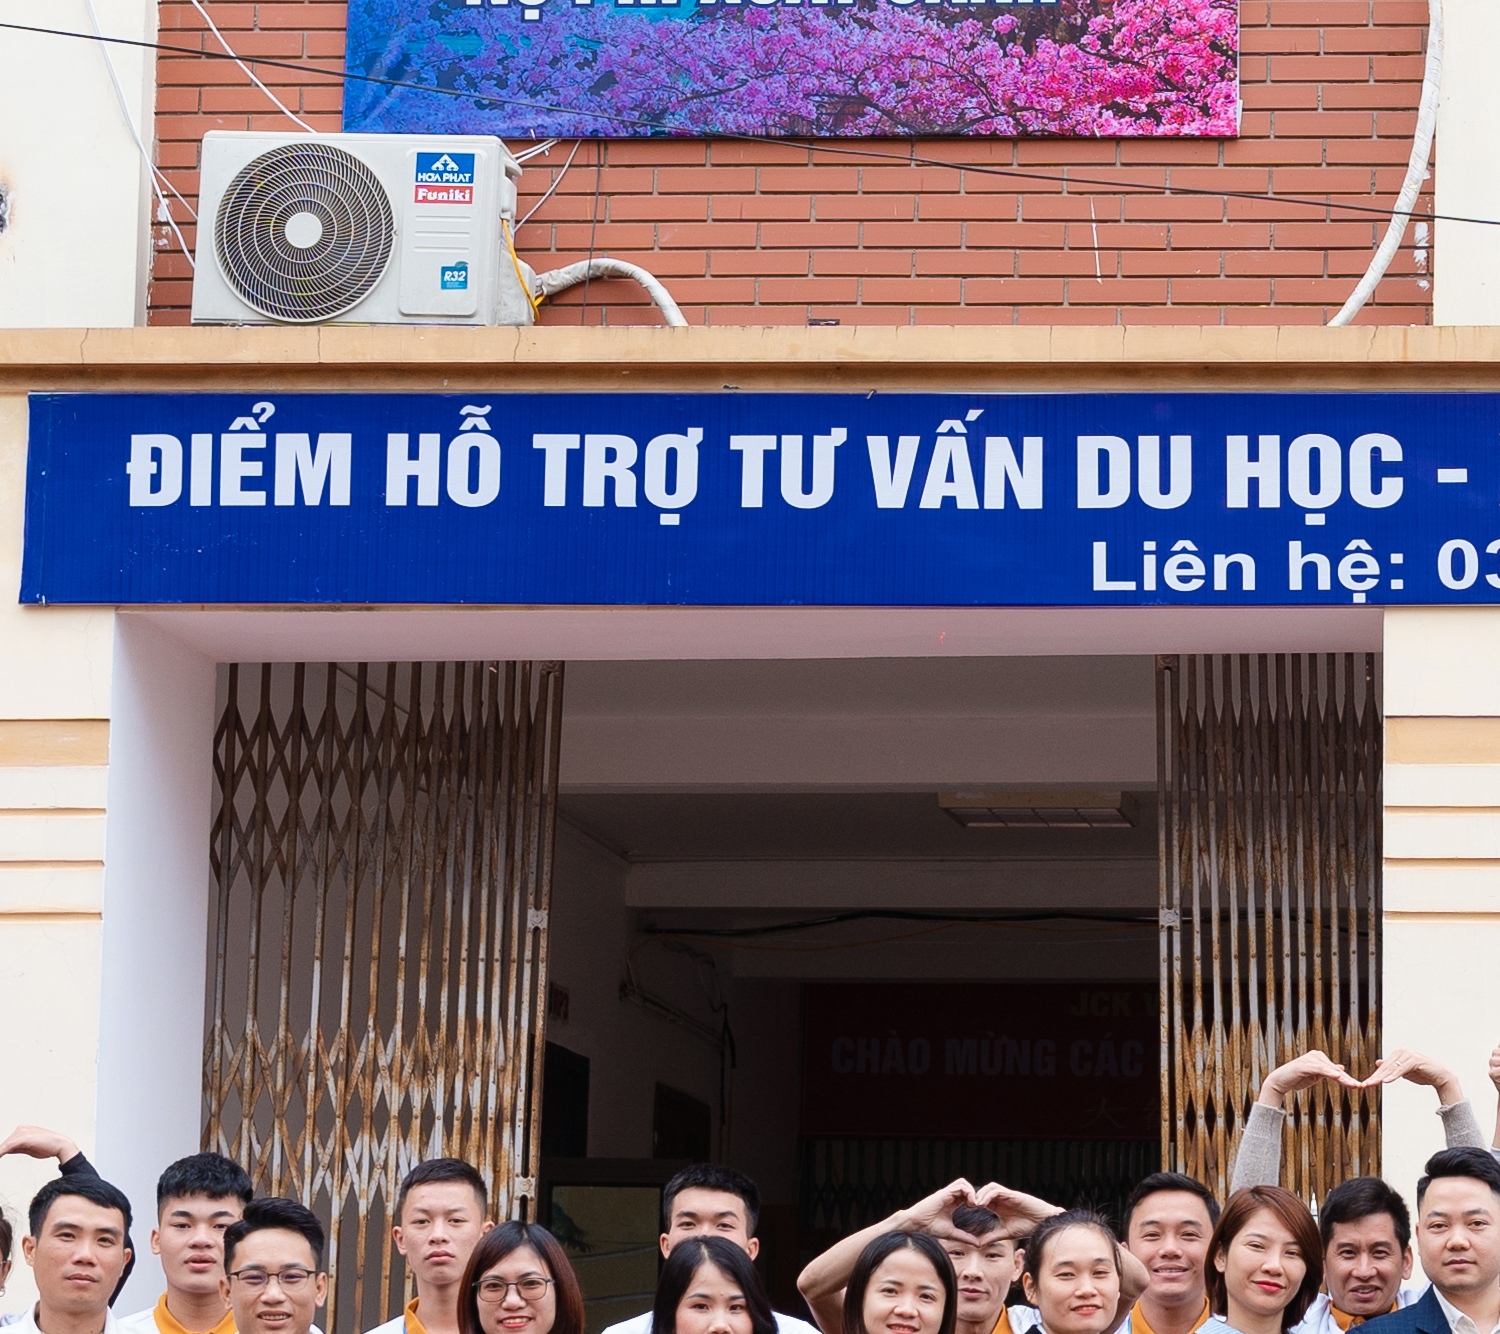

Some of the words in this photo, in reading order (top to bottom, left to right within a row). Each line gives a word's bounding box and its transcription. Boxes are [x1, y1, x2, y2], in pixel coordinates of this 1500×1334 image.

[417, 188, 470, 203] Funiki
[444, 271, 466, 281] R32
[127, 401, 351, 506] ĐIỂM
[386, 404, 500, 507] HỖ
[533, 428, 703, 526] TRỢ
[730, 428, 847, 508] TƯ
[867, 410, 1042, 509] VẤN
[1078, 436, 1191, 509] DU
[1227, 433, 1403, 526] HỌC
[1093, 540, 1255, 592] Liên
[1287, 538, 1405, 601] hệ:
[832, 1029, 929, 1075] CHÀO
[945, 1030, 1056, 1076] MỪNG
[1070, 1032, 1143, 1076] CÁC
